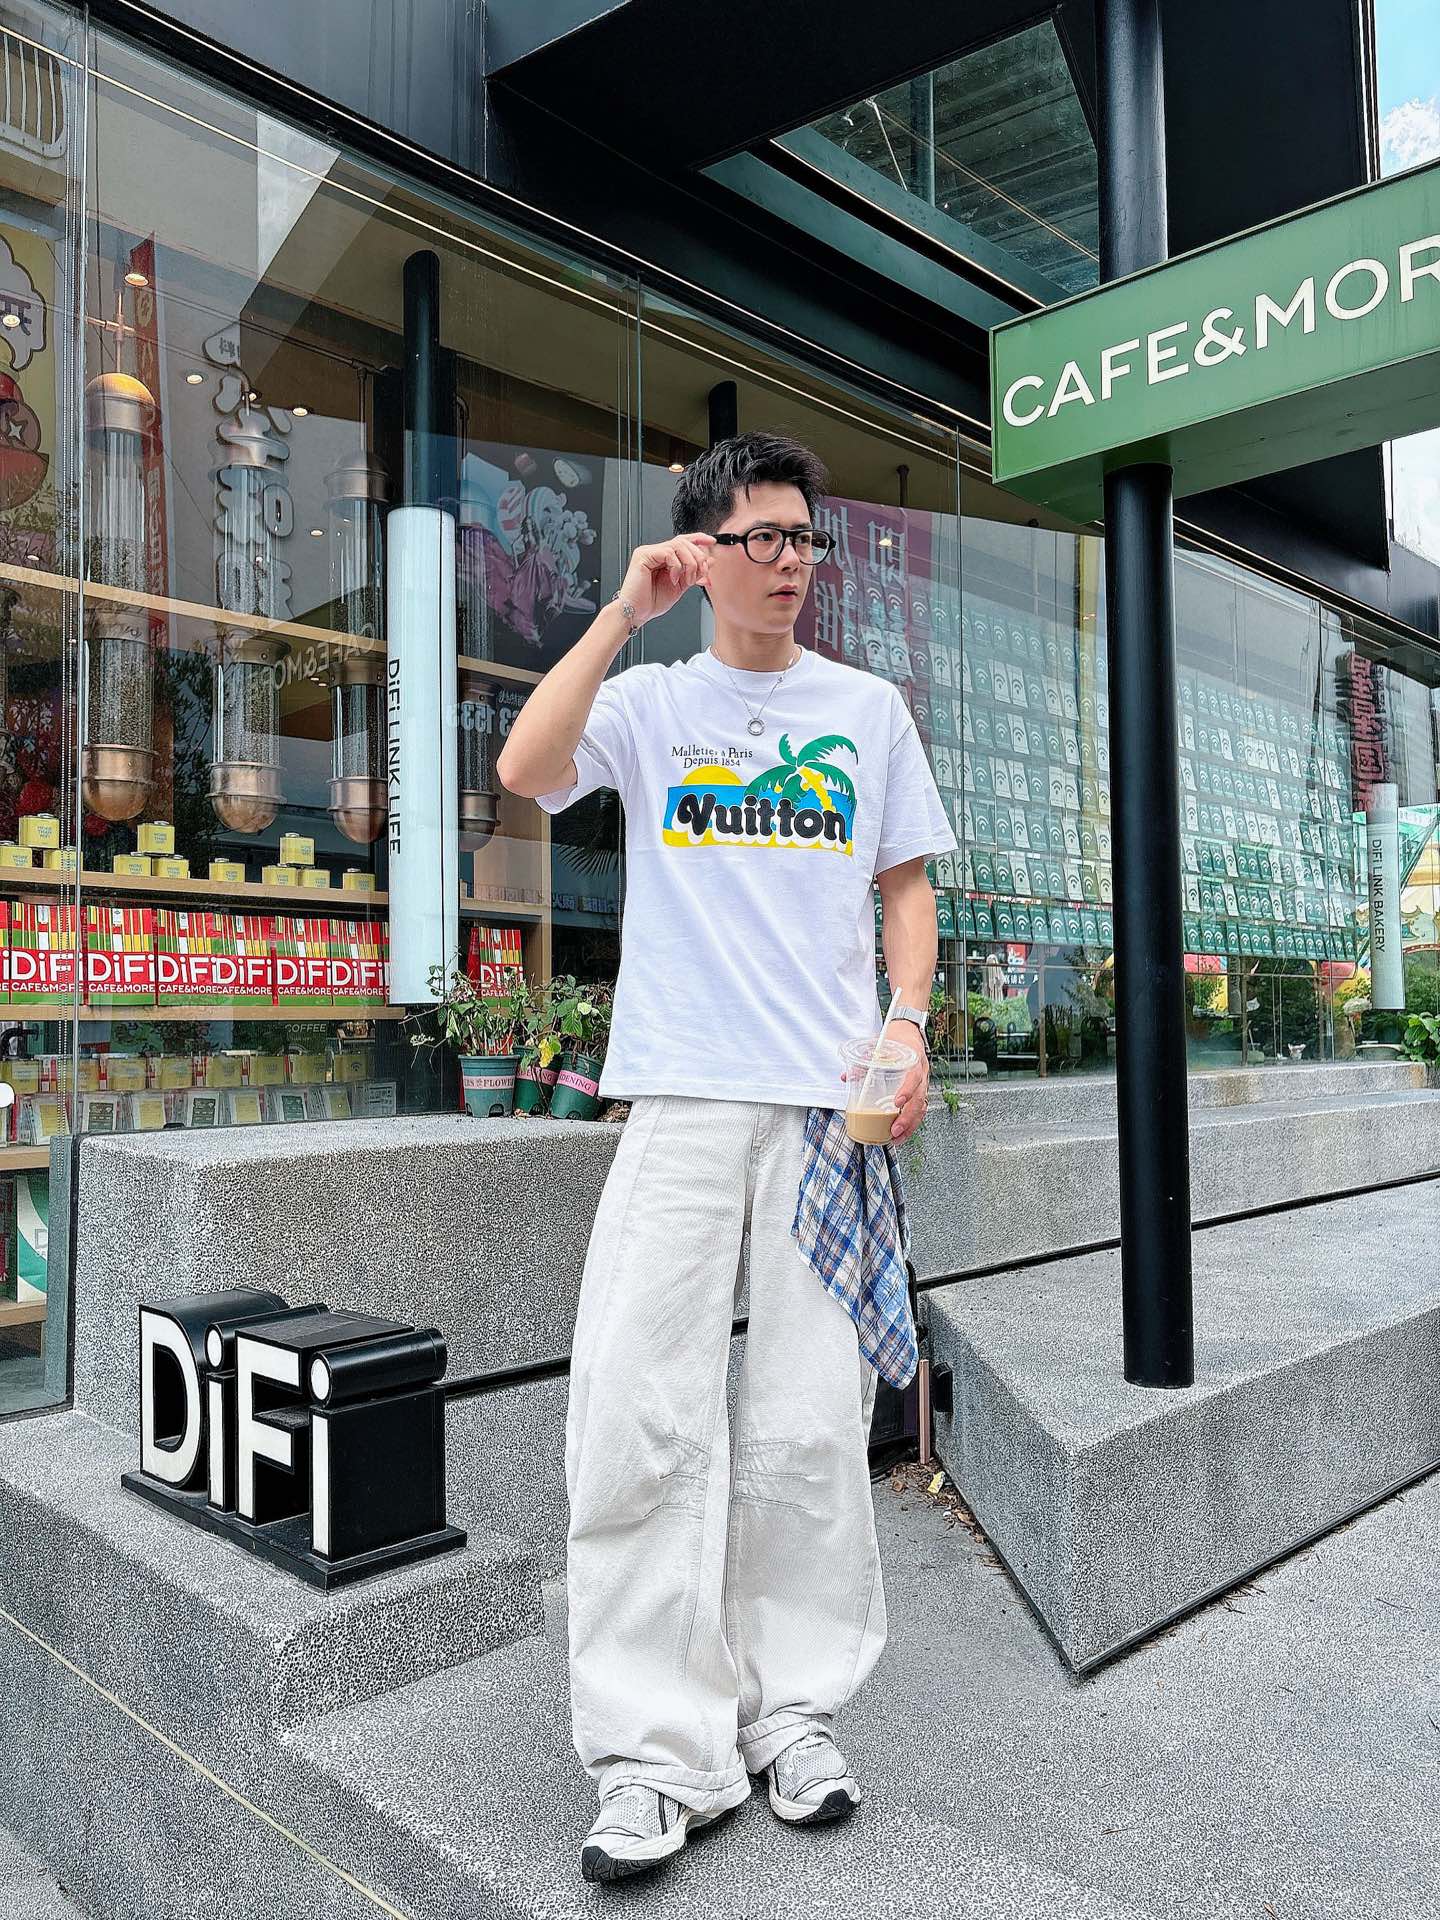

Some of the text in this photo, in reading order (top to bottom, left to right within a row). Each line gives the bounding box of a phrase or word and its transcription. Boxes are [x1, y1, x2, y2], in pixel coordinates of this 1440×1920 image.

[388, 658, 401, 856] DiFi LINK LIFE
[683, 757, 741, 768] Depuis 1854
[728, 747, 753, 758] Paris
[677, 793, 848, 845] Vuitton
[1372, 839, 1385, 953] DiFi LINK BAKERY
[87, 953, 155, 983] DiFi
[158, 955, 216, 983] DiFi
[214, 957, 272, 985] DiFi
[277, 959, 332, 986] DiFi
[332, 960, 384, 987] DiFi
[88, 983, 156, 993] CAFE&MORE
[159, 985, 217, 993] CAFE&MORE
[216, 986, 272, 995] CAFE&MORE
[277, 986, 332, 995] CAFE&MORE
[332, 987, 384, 996] CAFE&MORE
[285, 1023, 327, 1032] COFFEE
[140, 1306, 334, 1561] DiFi
